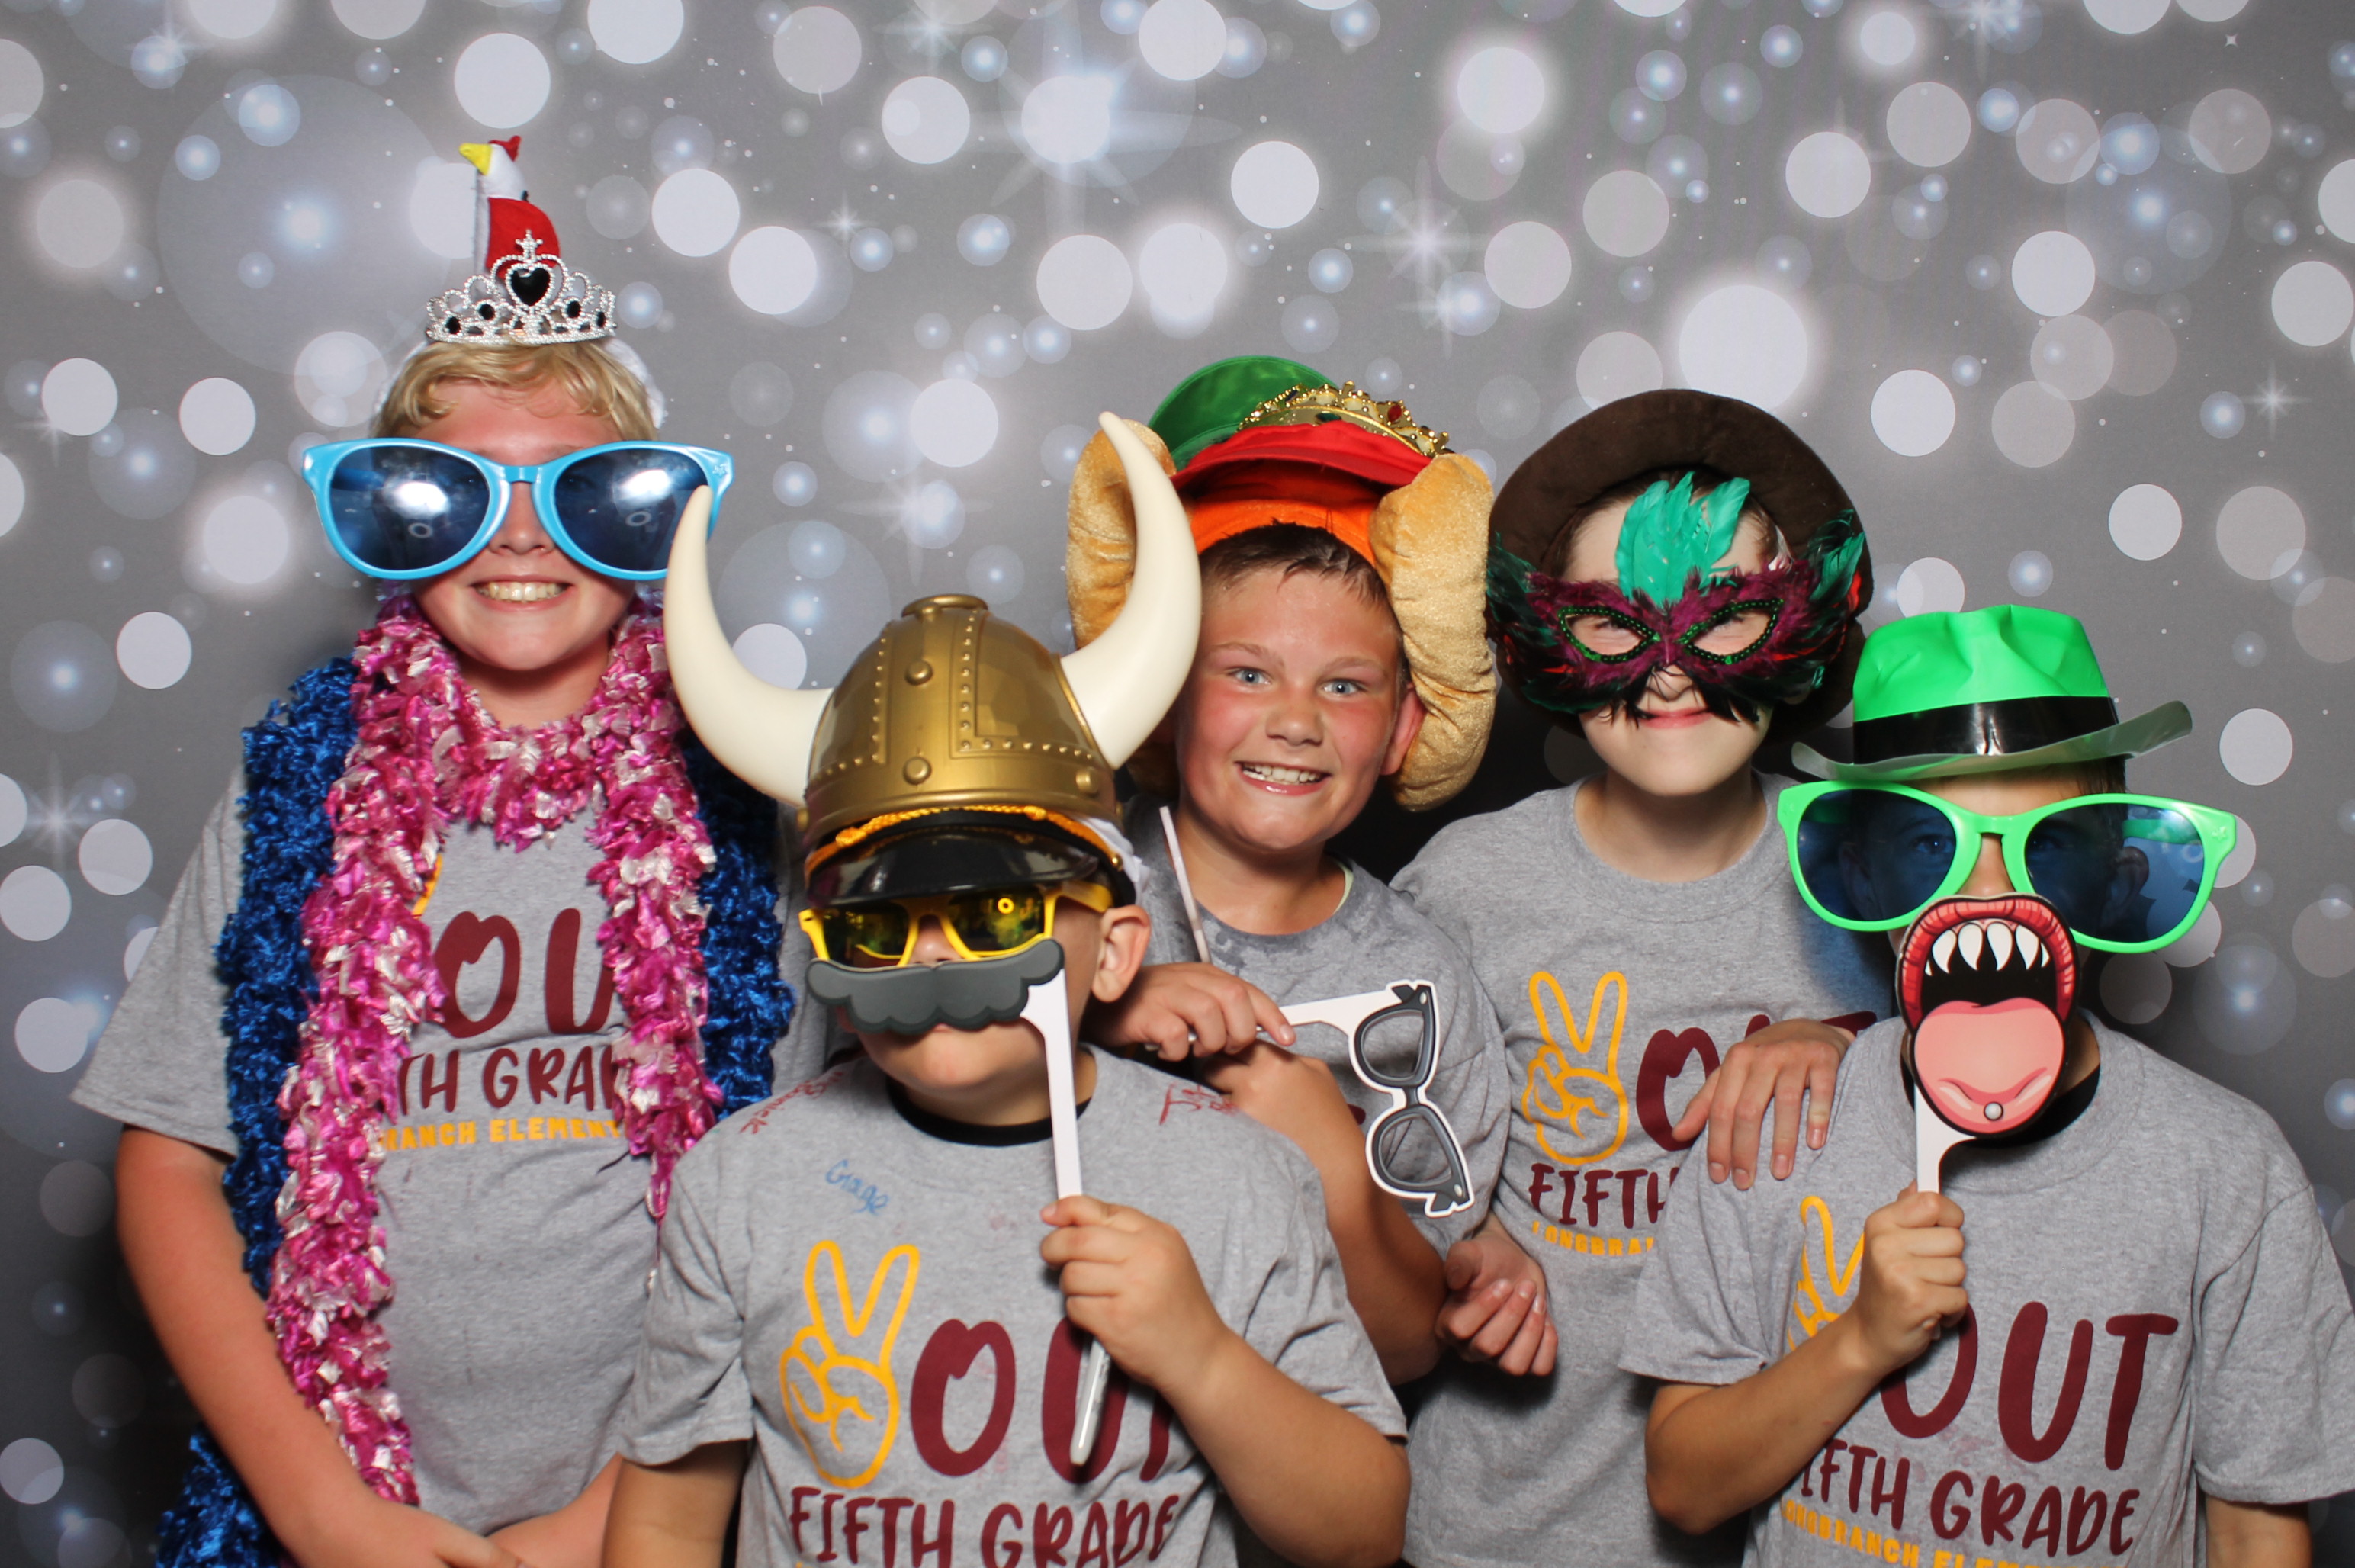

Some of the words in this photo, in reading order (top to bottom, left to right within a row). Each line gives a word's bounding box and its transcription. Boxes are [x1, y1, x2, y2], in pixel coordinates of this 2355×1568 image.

[434, 908, 615, 1039] OU
[483, 1045, 615, 1112] GRA
[490, 1117, 620, 1142] ELEMENT
[789, 1486, 955, 1568] FIFTH
[1801, 1439, 1910, 1531] IFTH
[1929, 1470, 2141, 1558] GRADE
